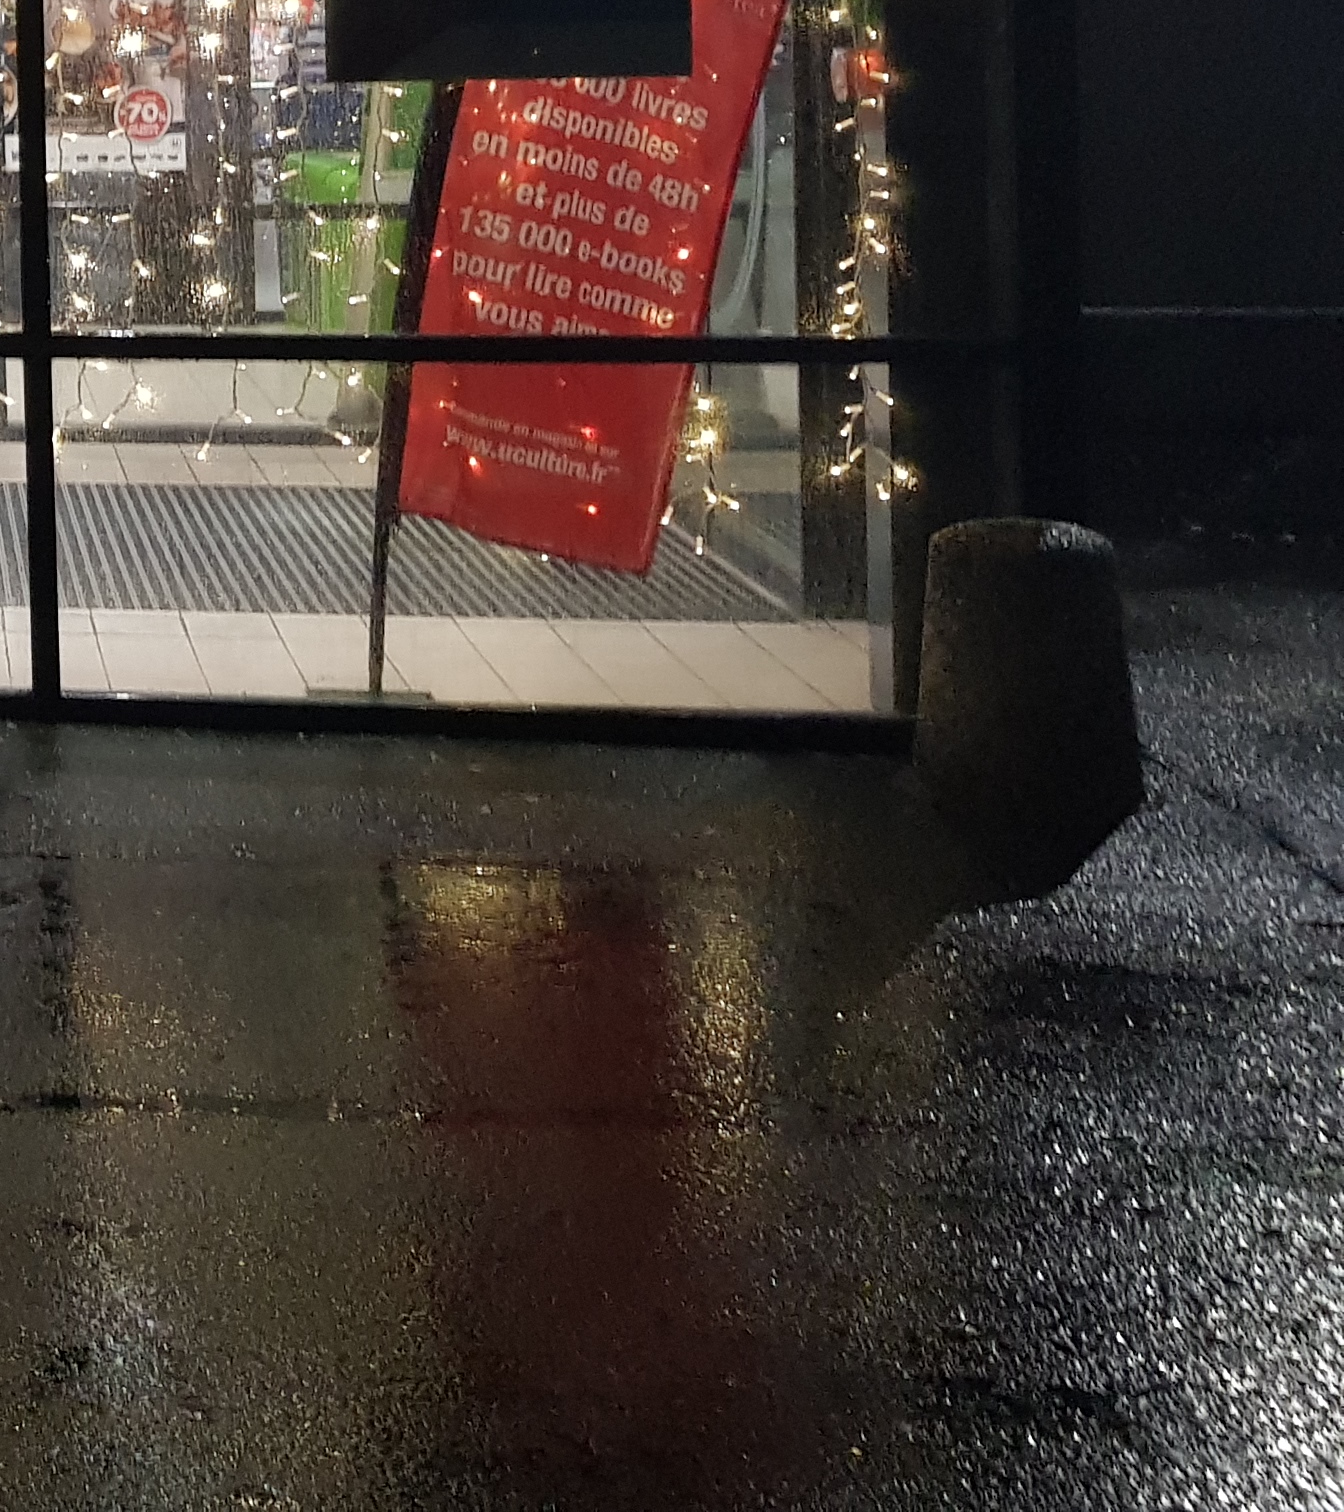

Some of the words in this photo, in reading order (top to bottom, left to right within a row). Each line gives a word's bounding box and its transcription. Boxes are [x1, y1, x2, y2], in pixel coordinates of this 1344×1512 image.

[523, 95, 679, 165] disponibles
[631, 82, 709, 130] livres
[473, 130, 509, 158] en
[517, 140, 599, 181] moins
[607, 159, 642, 192] de
[648, 173, 699, 213] 48h
[516, 180, 548, 210] et
[552, 189, 606, 224] plus
[614, 204, 650, 235] de
[460, 204, 511, 243] 135
[519, 220, 573, 257] 000
[578, 238, 686, 294] e-books
[452, 249, 523, 287] pour
[525, 261, 573, 299] lire
[578, 280, 676, 329] comme
[474, 300, 543, 336] vous
